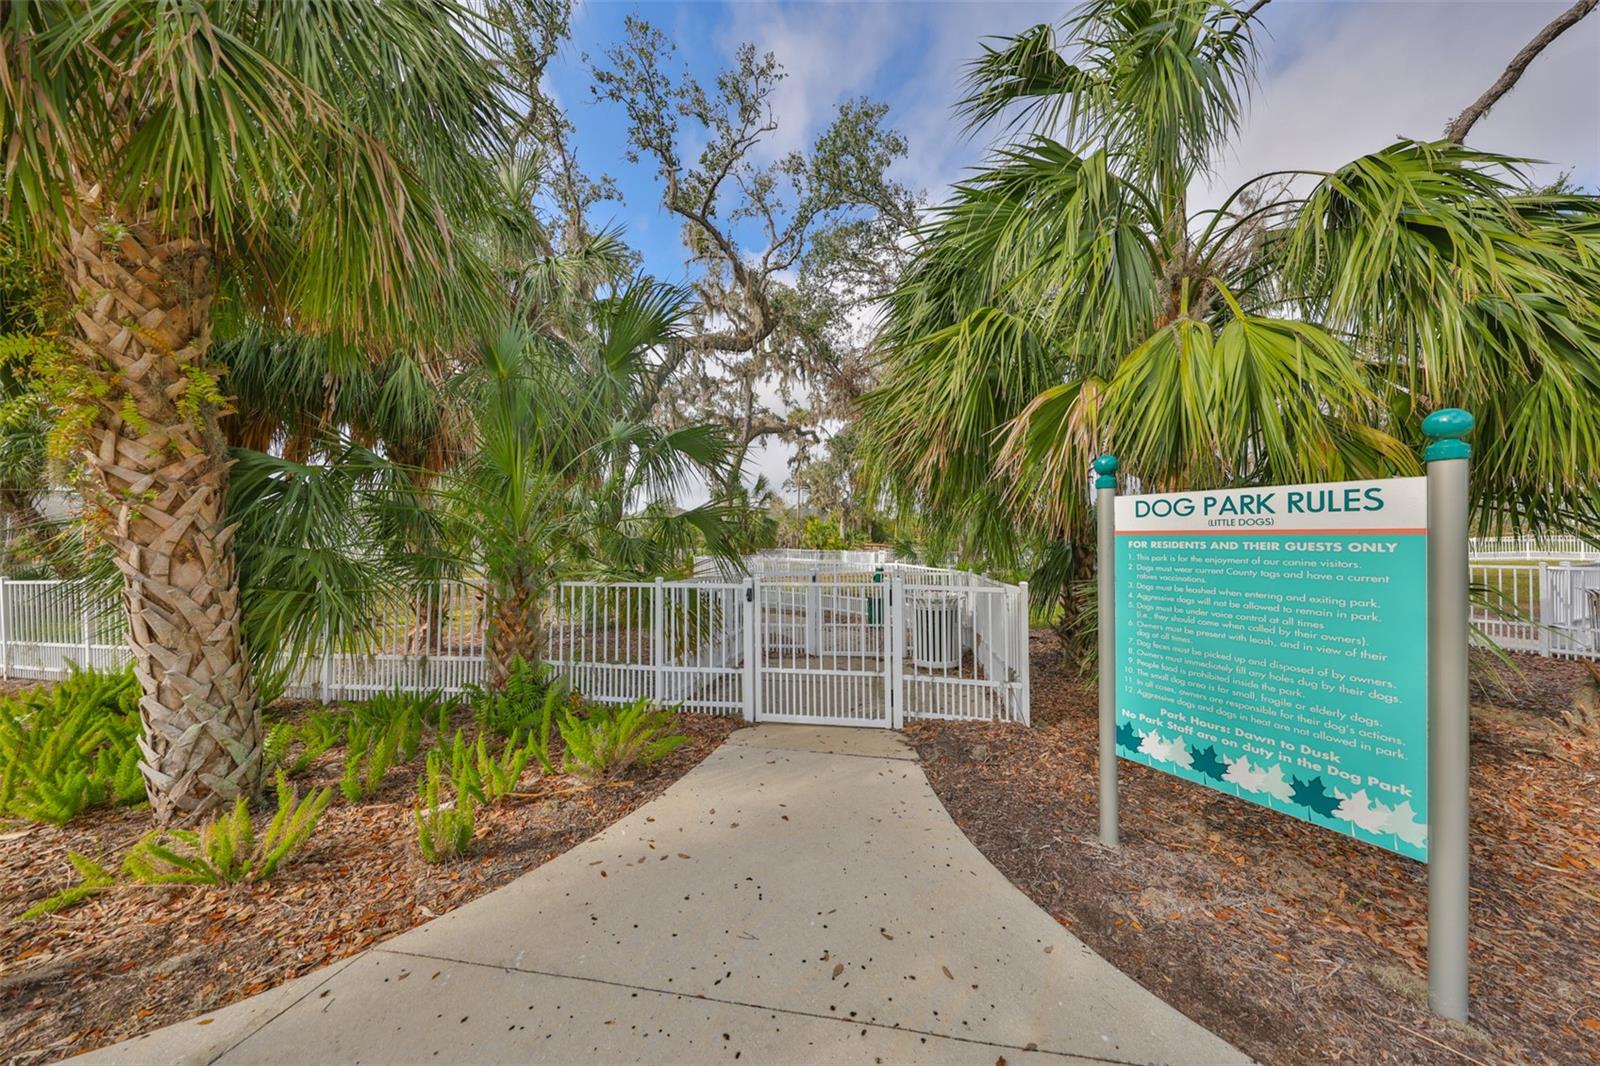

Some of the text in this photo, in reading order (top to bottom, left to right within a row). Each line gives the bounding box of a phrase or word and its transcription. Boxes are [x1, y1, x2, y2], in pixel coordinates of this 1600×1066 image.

[1135, 487, 1384, 518] DOG PARK RULES
[1238, 518, 1274, 526] DOGS)
[1151, 541, 1206, 549] RESIDENTS
[1243, 542, 1279, 550] THEIR
[1284, 542, 1342, 552] GUESTS
[1348, 543, 1397, 552] ONLY
[1177, 554, 1188, 562] for
[1251, 556, 1261, 564] of
[1282, 559, 1317, 567] canine
[1320, 560, 1362, 568] visitors.
[1136, 564, 1154, 572] Dogs
[1226, 568, 1257, 577] County
[1260, 570, 1280, 579] tags
[1283, 570, 1303, 578] and
[1306, 571, 1332, 580] have
[1136, 582, 1154, 591] Dogs
[1185, 586, 1216, 594] leashed
[1218, 588, 1242, 596] when
[1244, 592, 1283, 602] entering
[1286, 593, 1307, 602] and
[1309, 596, 1346, 607] exiting
[1349, 598, 1380, 609] park.
[1176, 596, 1195, 605] dogs
[1229, 600, 1240, 608] be
[1242, 602, 1279, 612] allowed
[1336, 610, 1346, 618] in
[1350, 612, 1382, 622] park.
[1136, 602, 1153, 611] Dogs
[1186, 608, 1208, 616] under
[1235, 614, 1266, 622] control
[1282, 617, 1293, 625] all
[1297, 620, 1324, 629] times
[1154, 613, 1168, 621] they
[1171, 615, 1195, 624] should
[1222, 621, 1245, 630] when
[1248, 624, 1275, 634] called
[1279, 627, 1291, 637] by
[1295, 629, 1317, 638] their
[1320, 634, 1369, 646] owners).
[1196, 630, 1226, 638] present
[1249, 636, 1277, 646] leash,
[1280, 641, 1299, 649] and
[1303, 643, 1312, 651] in
[1345, 648, 1357, 656] of
[1360, 650, 1387, 661] their
[1136, 639, 1151, 648] Dog
[1191, 648, 1202, 656] be
[1204, 651, 1231, 660] picked
[1248, 658, 1267, 666] and
[1269, 660, 1314, 674] disposed
[1317, 668, 1328, 676] of
[1331, 669, 1345, 681] by
[1349, 675, 1397, 688] owners.
[1161, 663, 1178, 672] food
[1188, 671, 1230, 683] prohibited
[1232, 679, 1259, 688] inside
[1261, 683, 1276, 692] the
[1279, 688, 1304, 697] park.
[1184, 658, 1233, 673] immediately
[1236, 666, 1246, 674] fill
[1248, 671, 1266, 680] any
[1269, 672, 1294, 683] holes
[1297, 677, 1318, 690] dug
[1321, 681, 1335, 692] by
[1338, 684, 1364, 696] their
[1368, 690, 1403, 704] dogs.
[1170, 676, 1186, 686] dog
[1187, 681, 1206, 689] area
[1217, 685, 1228, 693] for
[1232, 690, 1257, 700] small,
[1261, 694, 1292, 707] fragile
[1309, 705, 1346, 720] elderly
[1350, 712, 1383, 726] dogs.
[1176, 698, 1195, 709] dogs
[1216, 707, 1236, 719] dogs
[1239, 713, 1248, 721] in
[1250, 716, 1270, 726] heat
[1273, 723, 1290, 731] are
[1293, 727, 1309, 736] not
[1312, 731, 1356, 747] allowed
[1360, 742, 1371, 751] in
[1376, 747, 1408, 760] park.
[1178, 690, 1206, 700] owners
[1226, 700, 1277, 716] responsible
[1280, 709, 1294, 720] for
[1297, 714, 1320, 725] their
[1324, 720, 1355, 734] dog's
[1358, 730, 1406, 745] actions.
[1160, 708, 1340, 763] Park Hours: Dawn to Dusk
[1122, 709, 1412, 797] No Park Staff are on duty in the Dog Park
